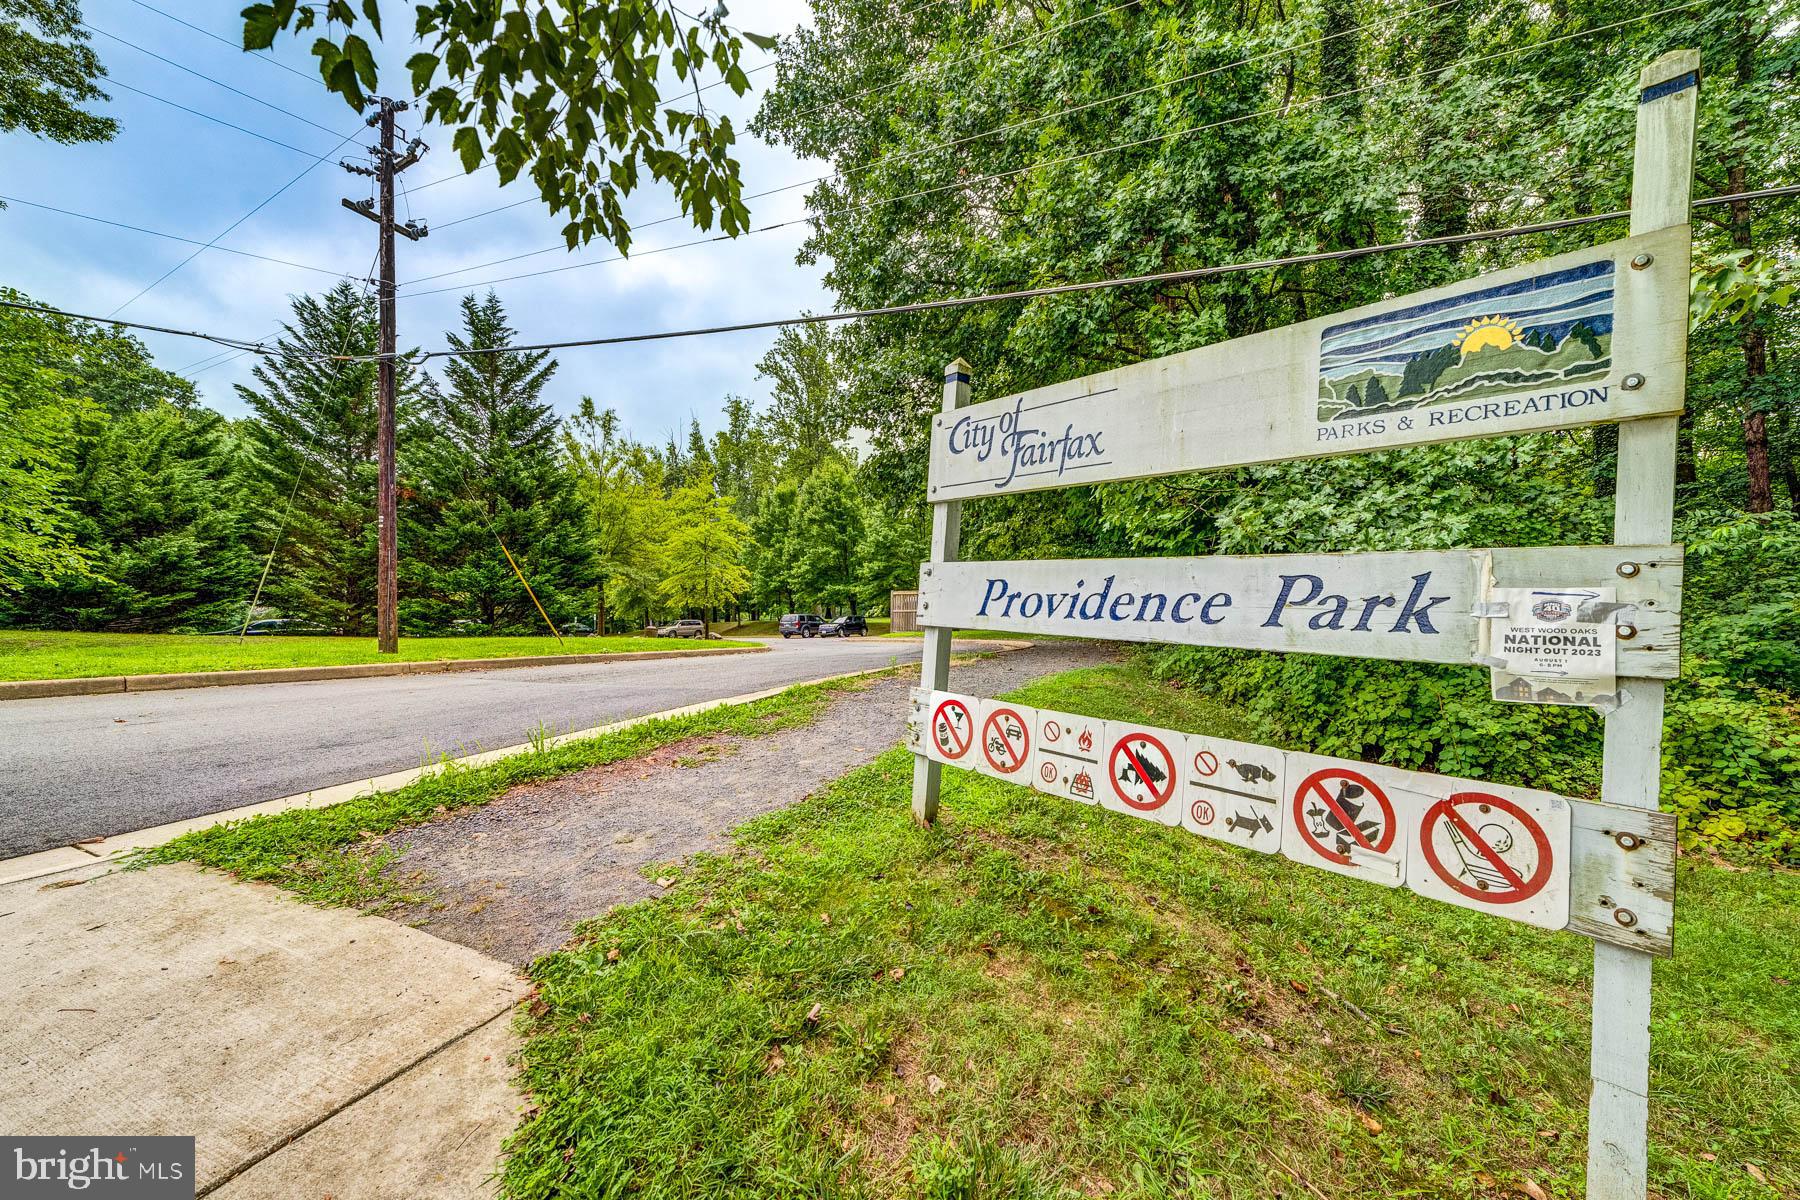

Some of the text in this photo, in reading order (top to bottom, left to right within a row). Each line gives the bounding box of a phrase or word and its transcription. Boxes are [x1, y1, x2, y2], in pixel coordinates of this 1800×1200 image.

[949, 397, 1024, 462] City of
[1316, 385, 1609, 442] PARKS & RECREATION
[995, 423, 1104, 488] Fairfax
[976, 571, 1451, 634] Providence Park
[1504, 634, 1602, 648] NATIONAL
[1504, 646, 1602, 657] NIGHT OUT 2023
[1045, 766, 1054, 779] OK
[1196, 805, 1209, 821] OK
